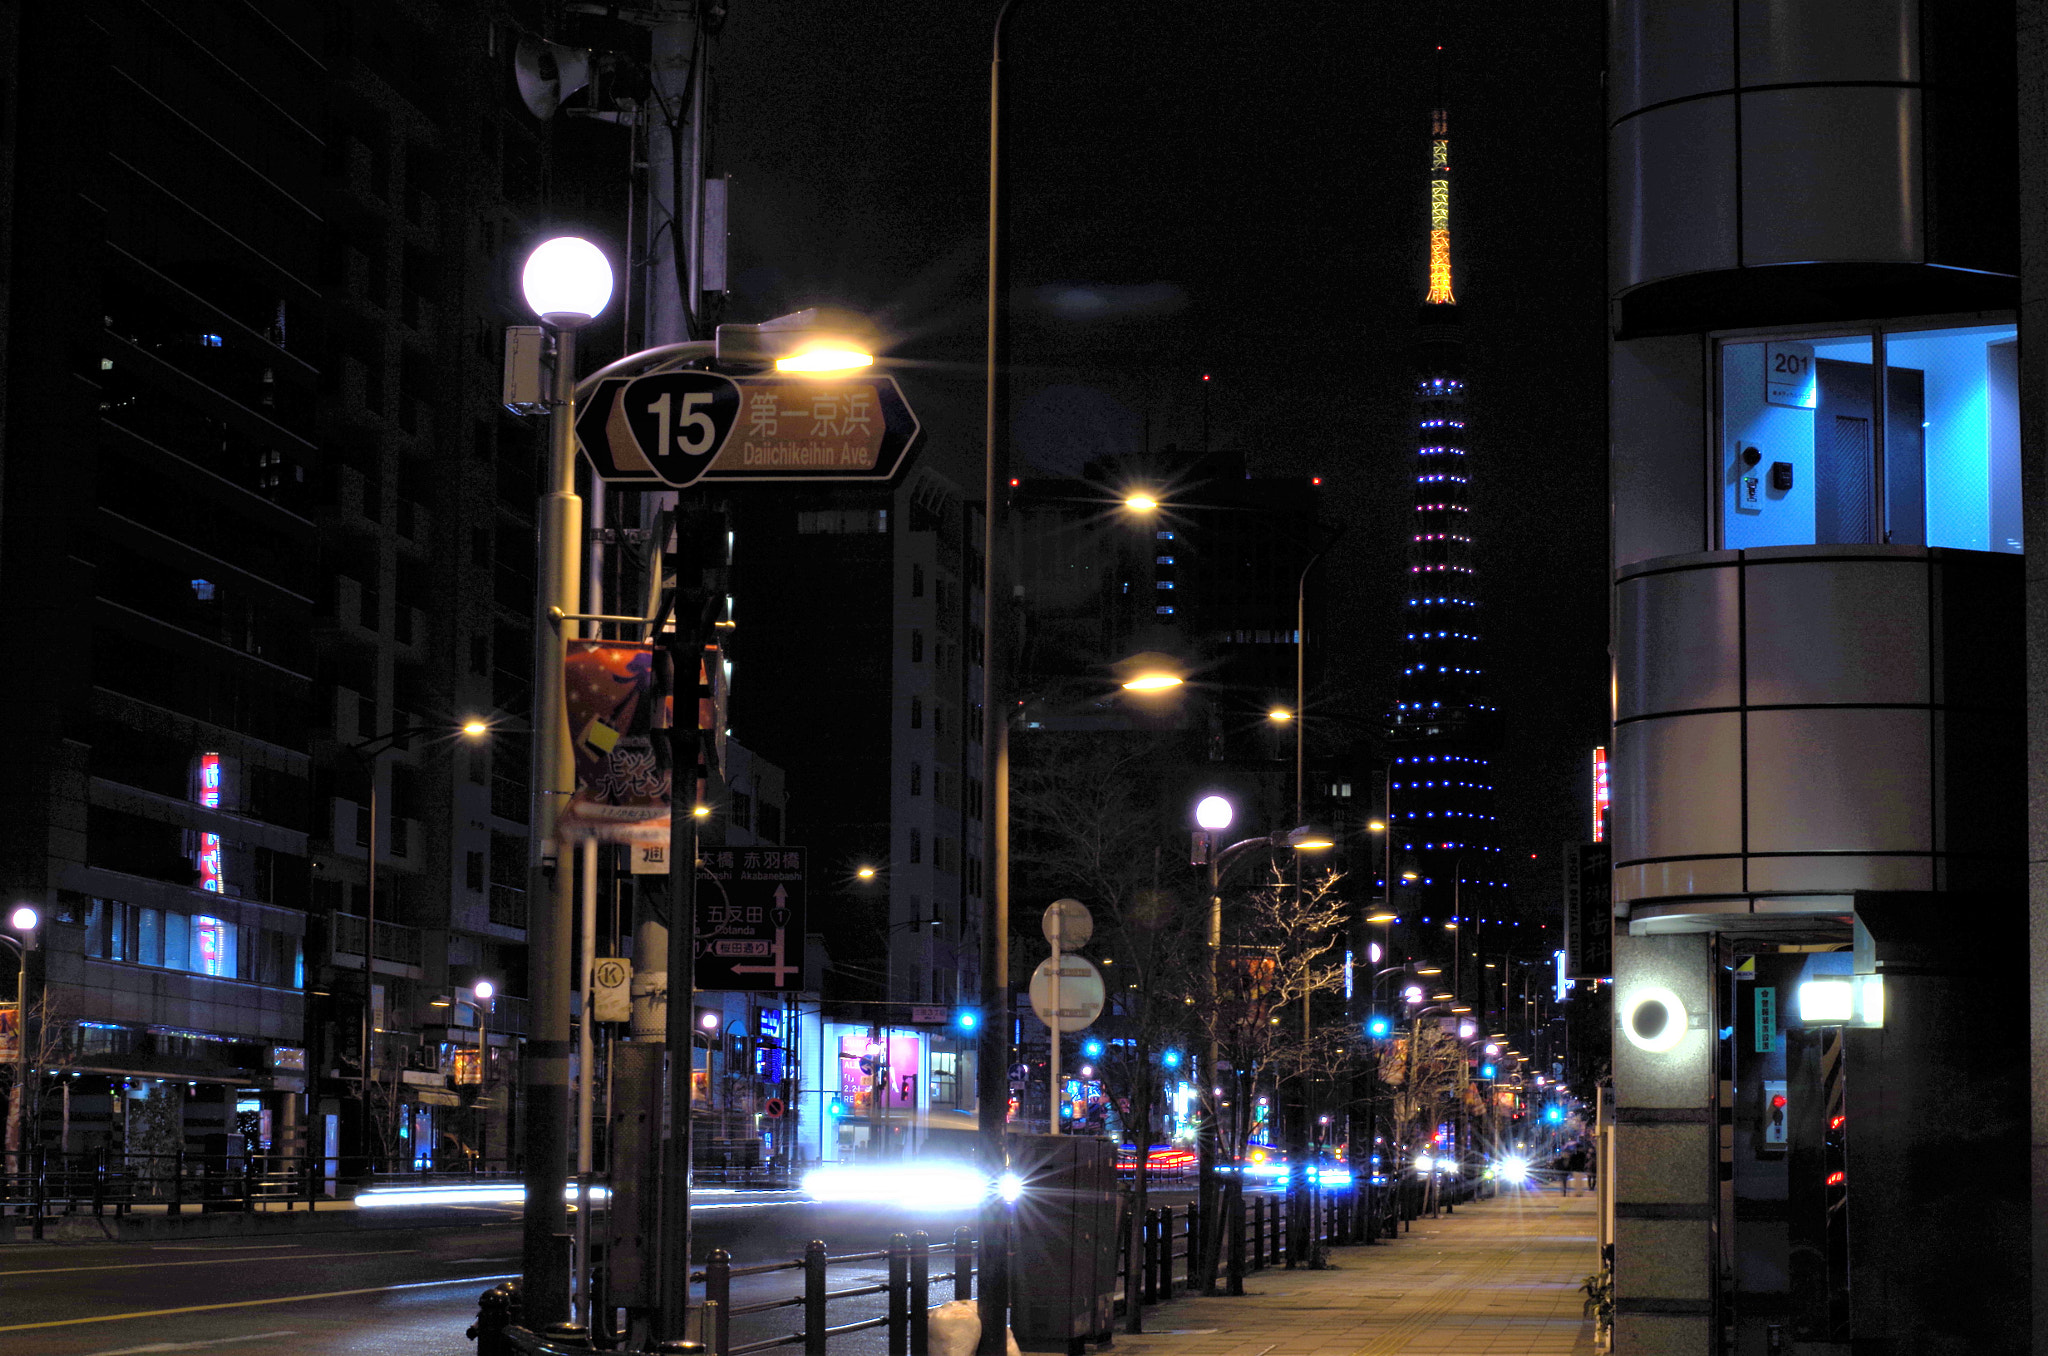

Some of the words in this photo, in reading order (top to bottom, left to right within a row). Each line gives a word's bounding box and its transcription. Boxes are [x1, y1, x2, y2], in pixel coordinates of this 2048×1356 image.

[1775, 353, 1808, 375] 201
[647, 392, 715, 455] 15
[749, 392, 870, 437] 第一京浜
[744, 442, 834, 465] Daiichikeihin
[841, 443, 871, 467] Ave.
[699, 851, 734, 869] 本橋
[744, 851, 800, 869] 赤羽橋
[707, 905, 763, 923] 五反田
[777, 911, 783, 923] 1
[1570, 889, 1578, 927] DENTAL
[1570, 932, 1578, 968] CLINIC
[605, 967, 617, 983] K
